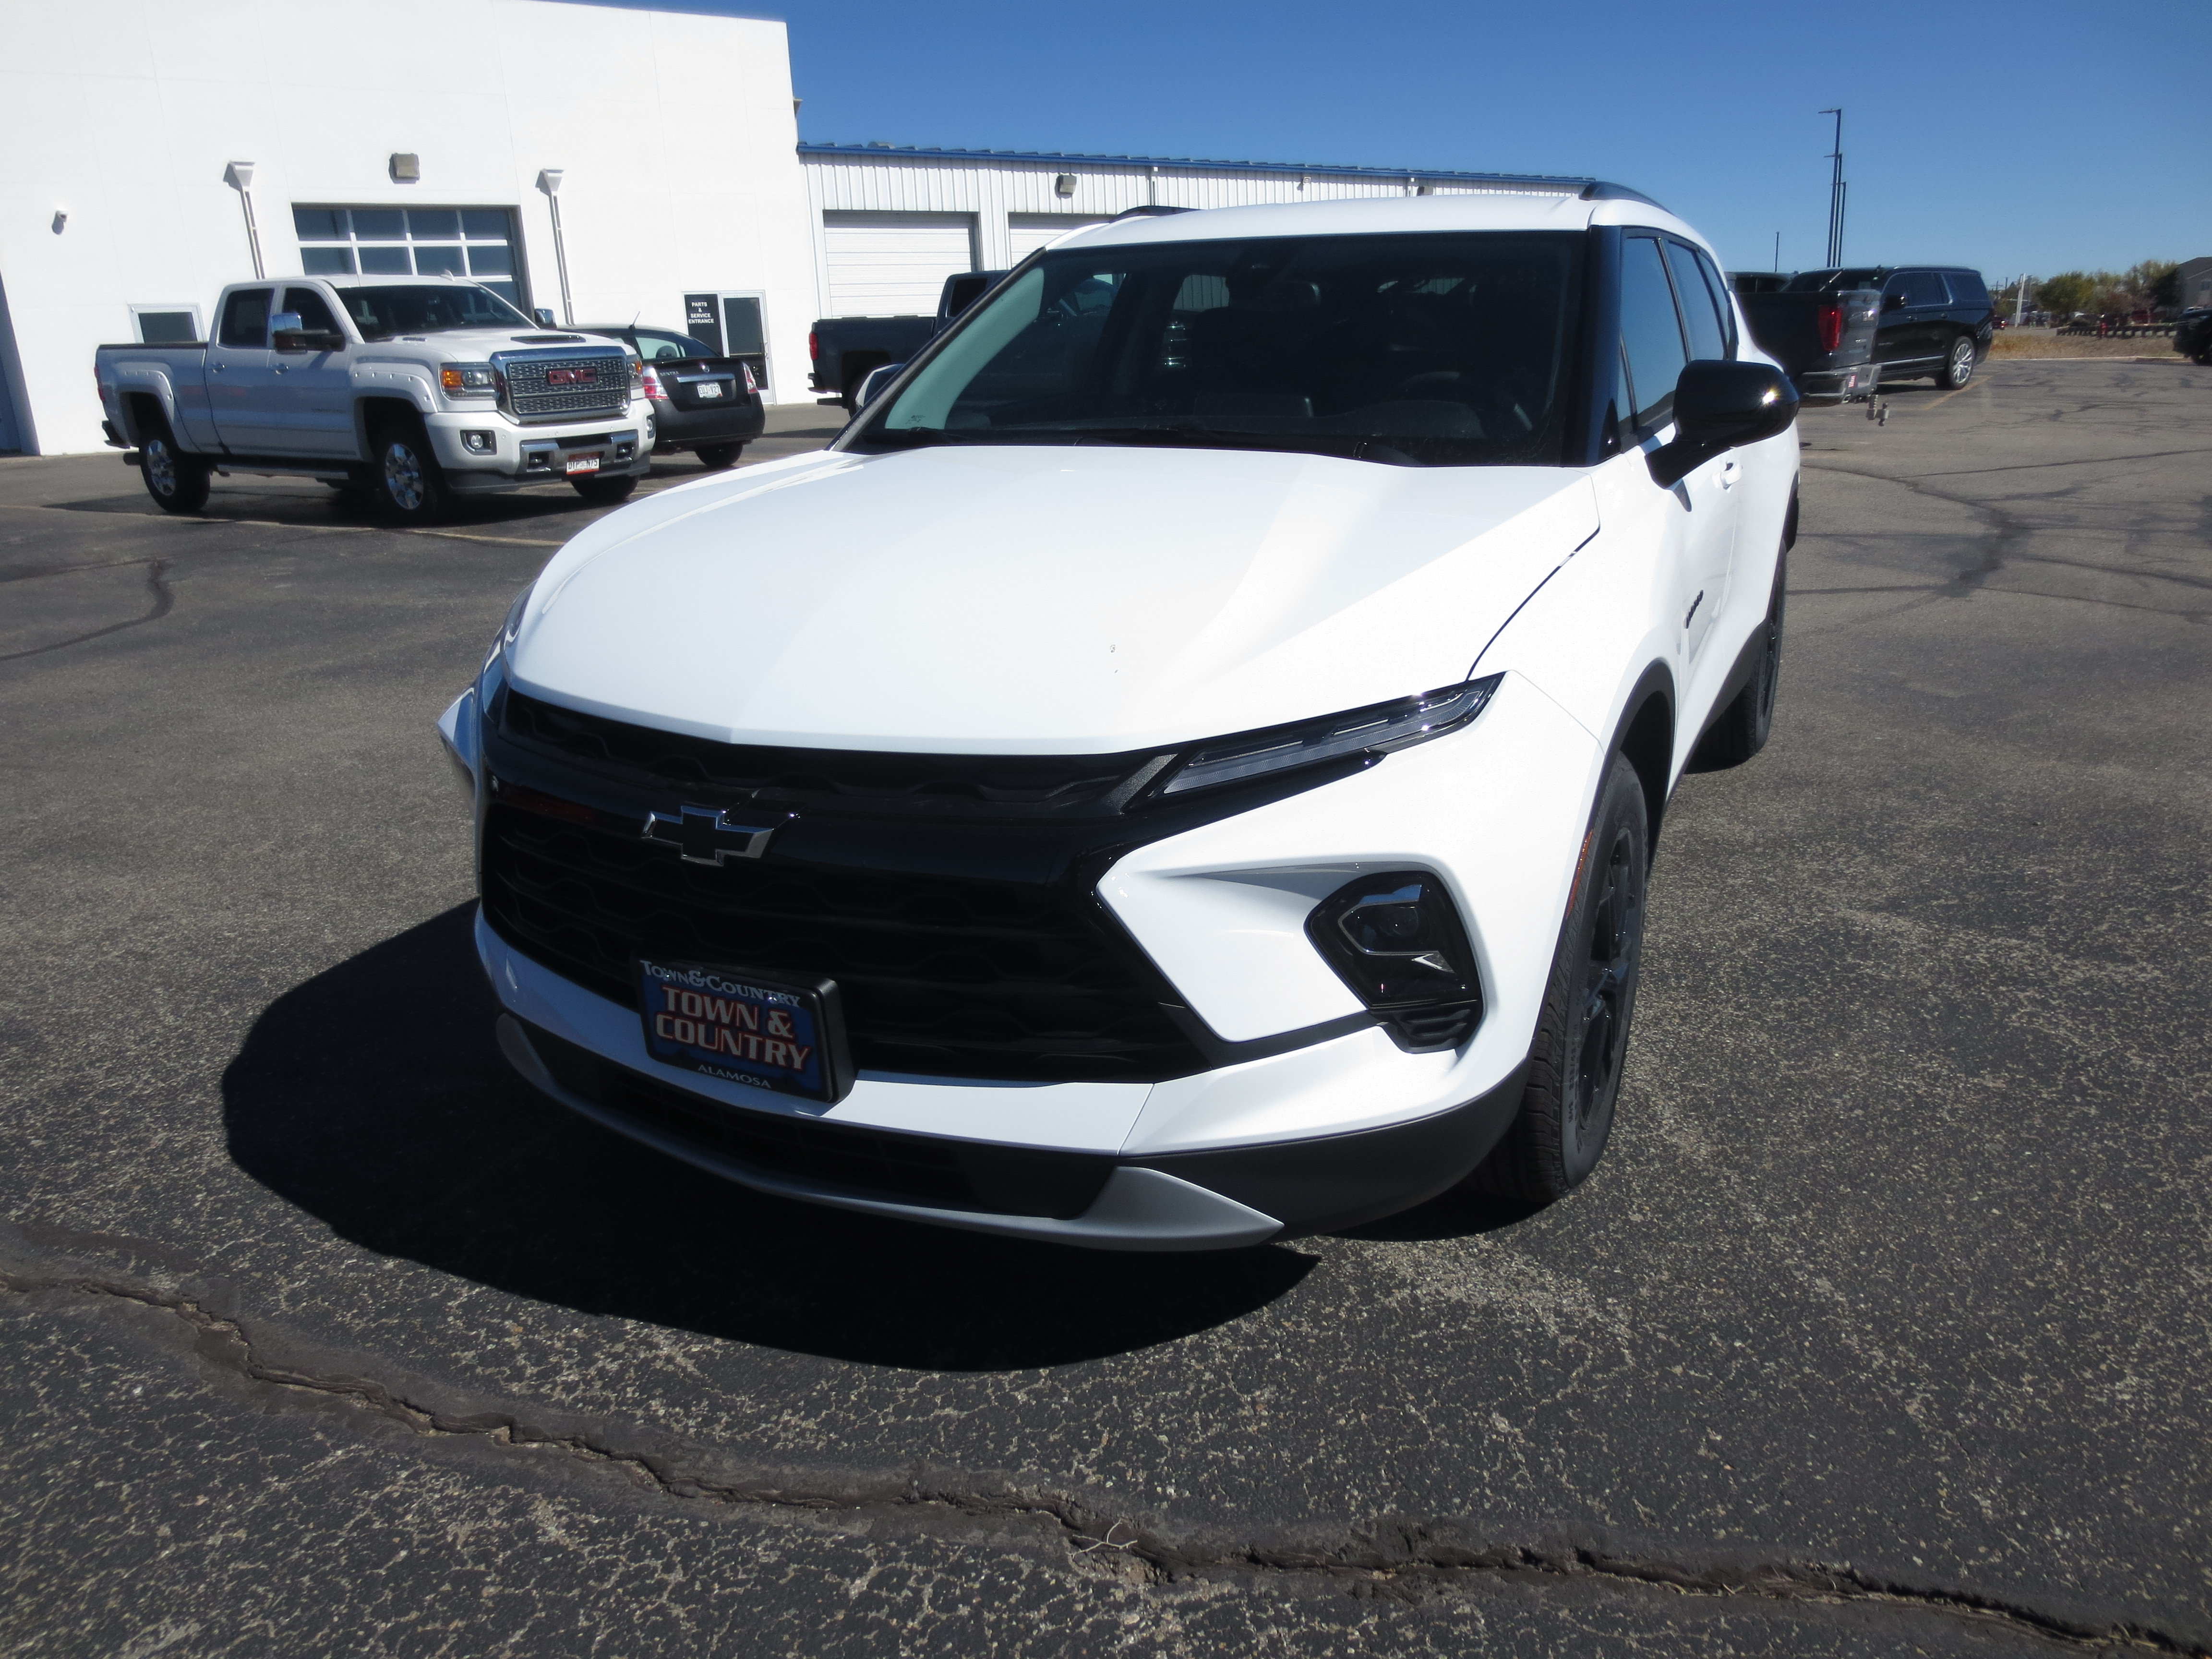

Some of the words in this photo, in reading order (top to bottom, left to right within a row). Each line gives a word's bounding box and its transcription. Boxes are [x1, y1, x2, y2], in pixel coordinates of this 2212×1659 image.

[549, 368, 596, 384] GMC
[661, 985, 760, 1032] TOWN
[768, 1010, 794, 1039] &
[656, 1012, 811, 1071] COUNTRY
[698, 1064, 771, 1089] ALAMOSA
